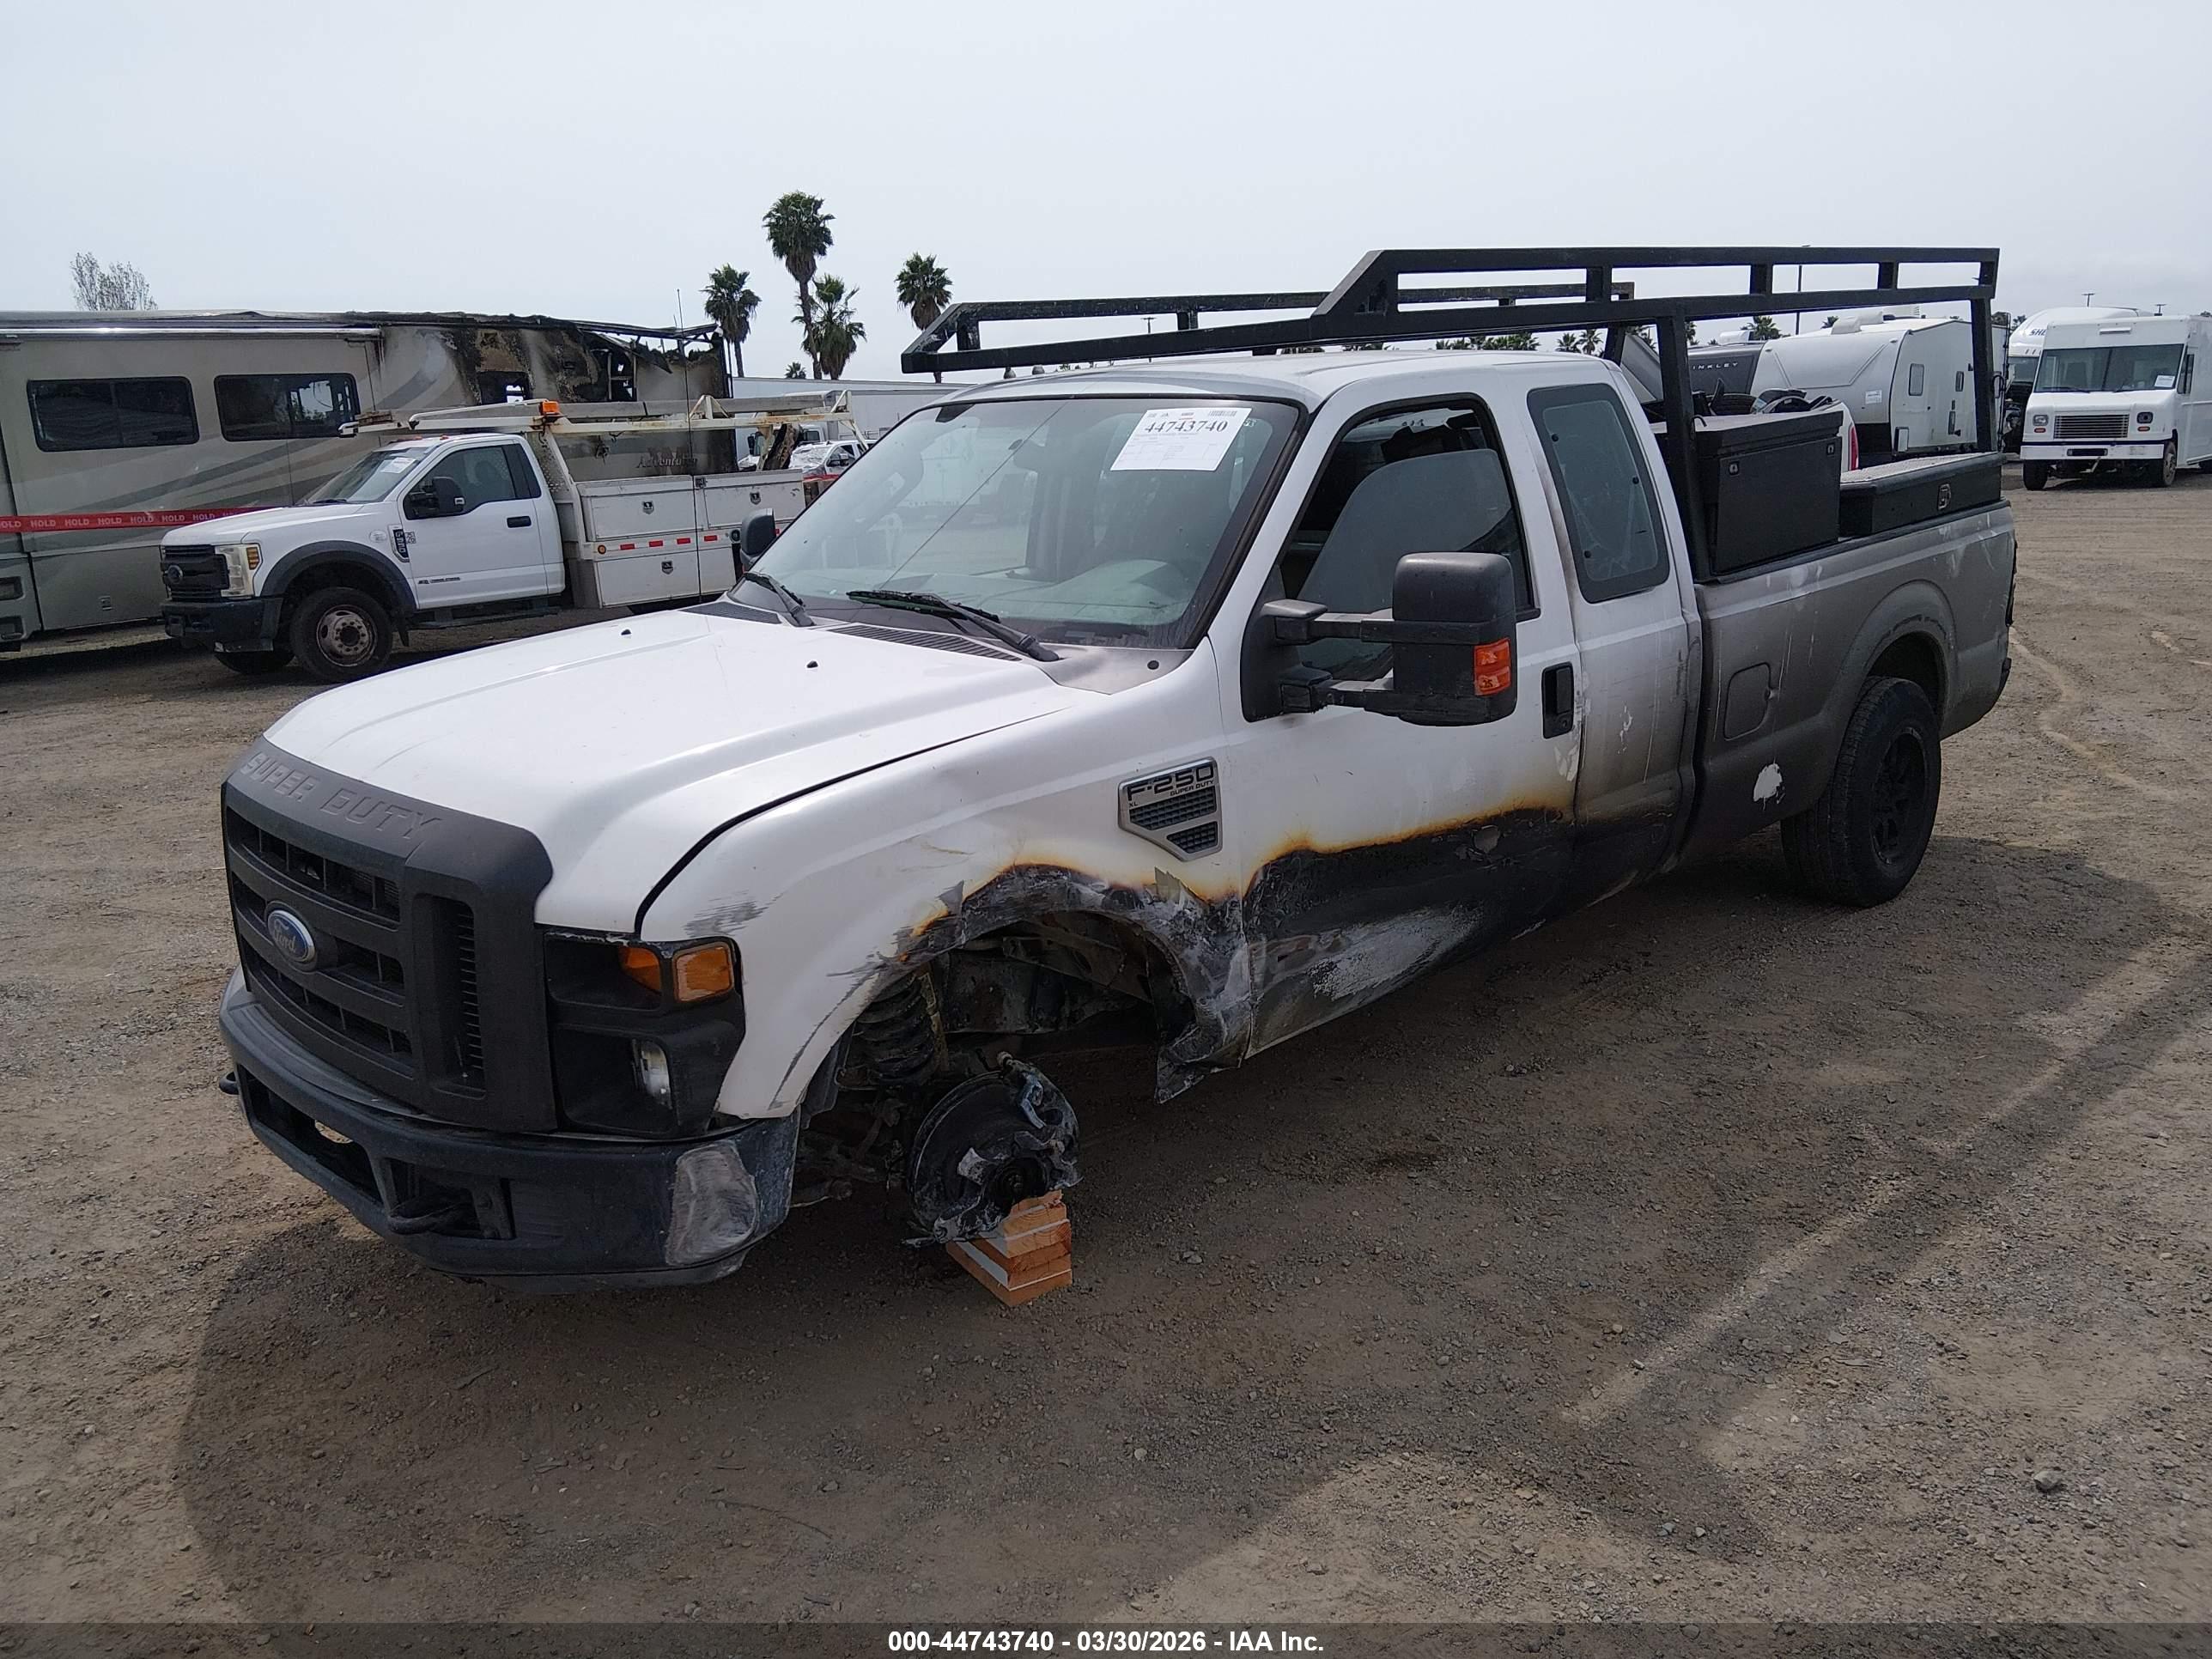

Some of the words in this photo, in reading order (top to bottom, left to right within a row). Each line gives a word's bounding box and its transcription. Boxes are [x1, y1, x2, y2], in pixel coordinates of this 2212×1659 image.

[1145, 419, 1229, 434] 44743740
[0, 520, 21, 529] OLD
[30, 519, 57, 528] HOLD
[64, 518, 90, 527] HOLD
[98, 517, 123, 526] HOLD
[131, 515, 155, 524] HOLD
[161, 514, 185, 523] HOLD
[240, 751, 321, 803] SUPER
[319, 787, 443, 840] DUTY
[1170, 784, 1194, 797] SUPER
[1195, 780, 1214, 789] DUTY
[274, 918, 297, 954] Ford
